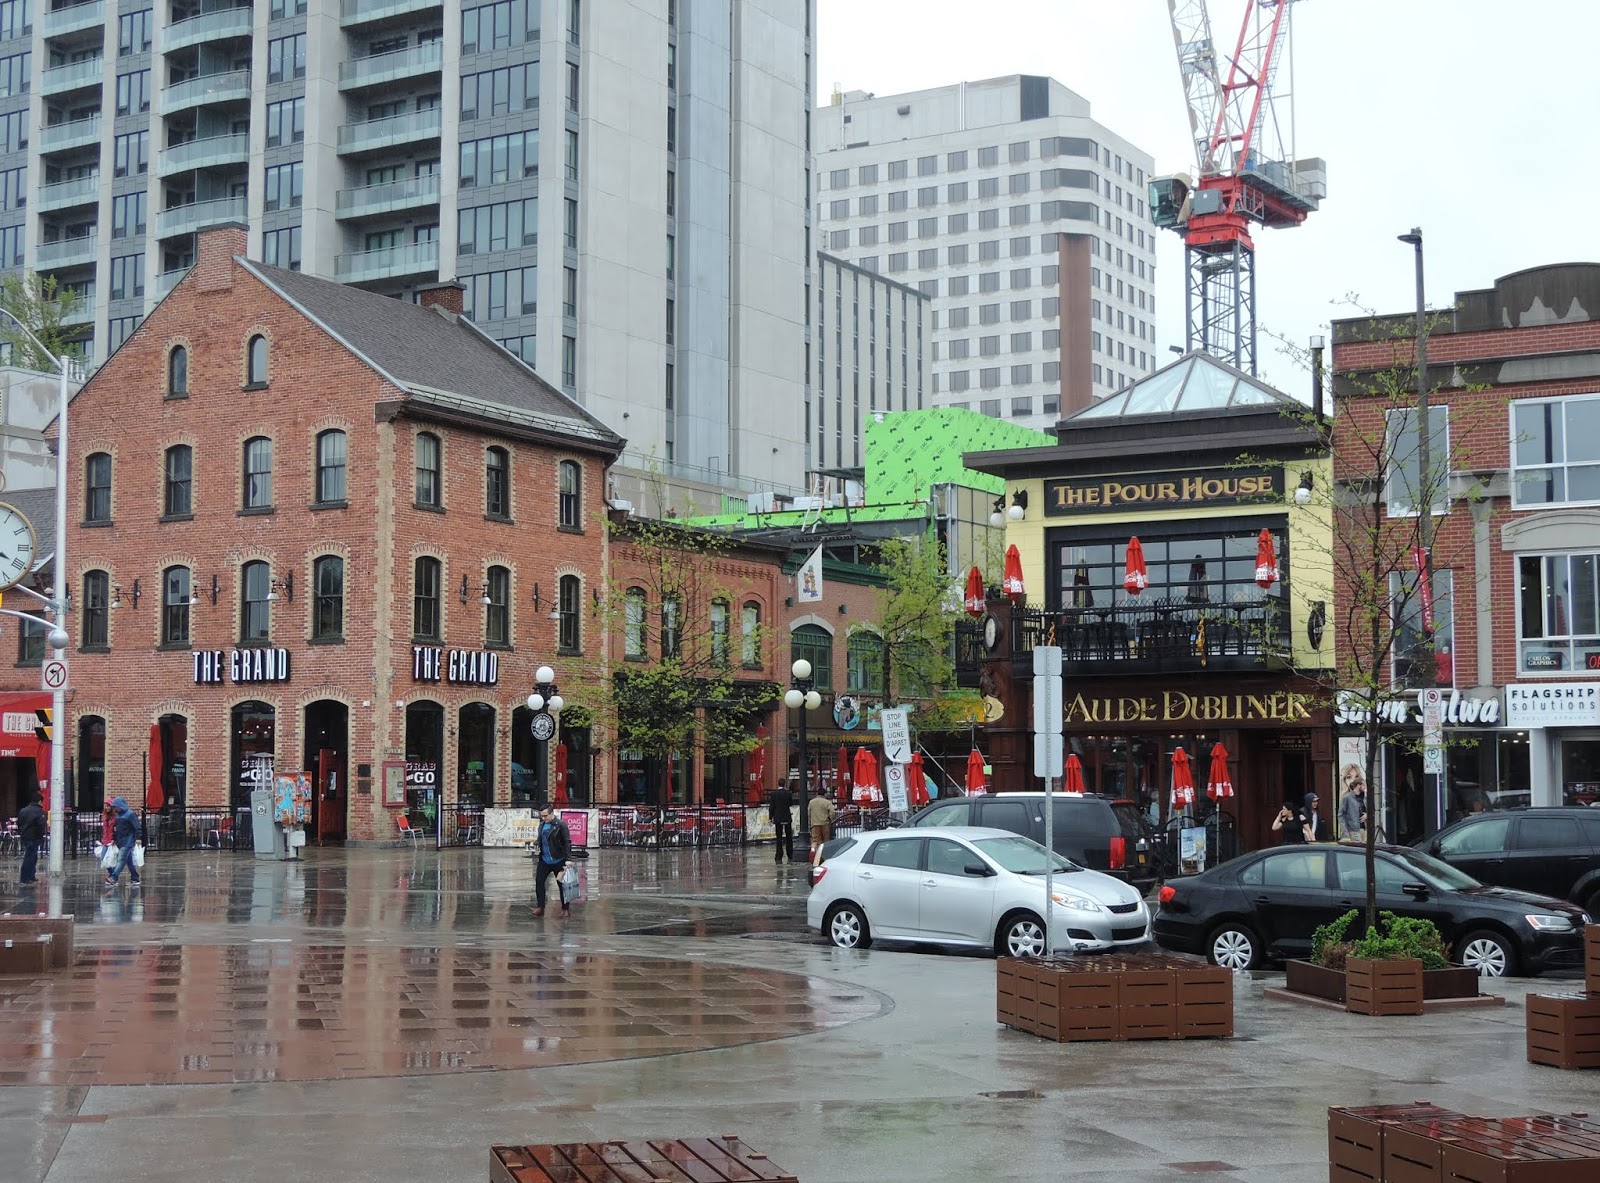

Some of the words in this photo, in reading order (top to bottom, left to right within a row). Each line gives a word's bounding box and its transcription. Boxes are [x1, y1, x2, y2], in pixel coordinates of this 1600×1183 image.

[1053, 486, 1100, 507] THE
[1101, 482, 1180, 506] POUR
[1180, 476, 1274, 502] HOUSE
[192, 651, 221, 682] THE
[231, 648, 287, 682] GRAND
[414, 647, 441, 680] THE
[448, 649, 497, 683] GRAND
[1511, 688, 1594, 699] FLAGSHIP
[1063, 691, 1157, 723] AULDE
[1162, 690, 1312, 722] DUBLINER
[1512, 699, 1595, 711] solutions
[5, 714, 21, 731] THE
[886, 713, 902, 721] STOP
[888, 721, 902, 729] LINE
[887, 731, 905, 739] LIGNE
[406, 762, 436, 771] GRAB
[414, 771, 435, 783] GO
